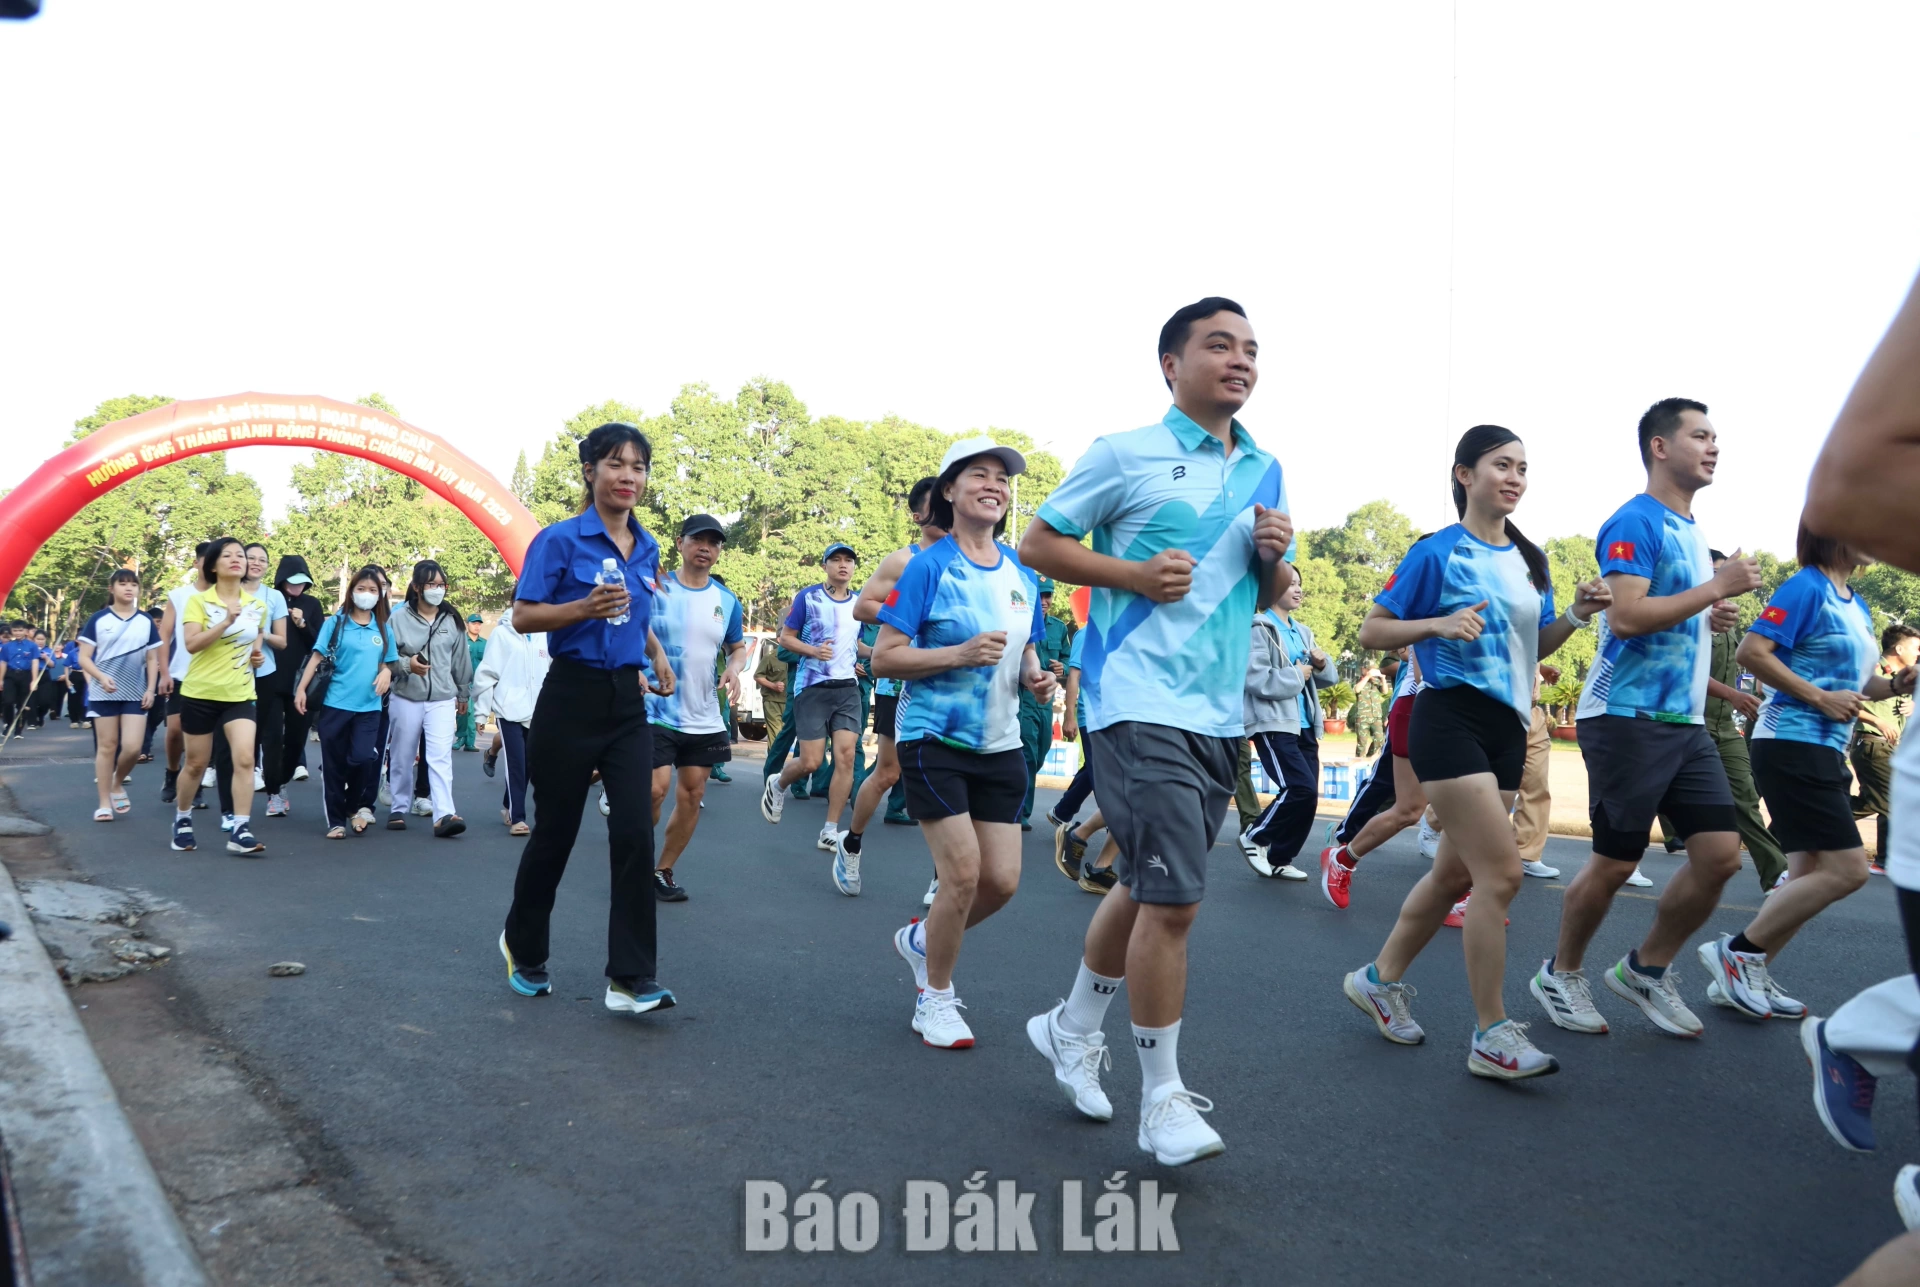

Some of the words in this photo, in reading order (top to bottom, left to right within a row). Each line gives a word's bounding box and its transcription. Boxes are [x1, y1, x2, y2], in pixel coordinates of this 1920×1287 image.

[175, 428, 228, 451] THÁNG
[231, 422, 272, 440] HÀNH
[277, 420, 316, 438] ĐỘNG
[368, 436, 416, 464] CHỐNG
[413, 453, 435, 474] MA
[360, 416, 398, 440] ĐỘNG
[399, 430, 436, 453] CHẠY
